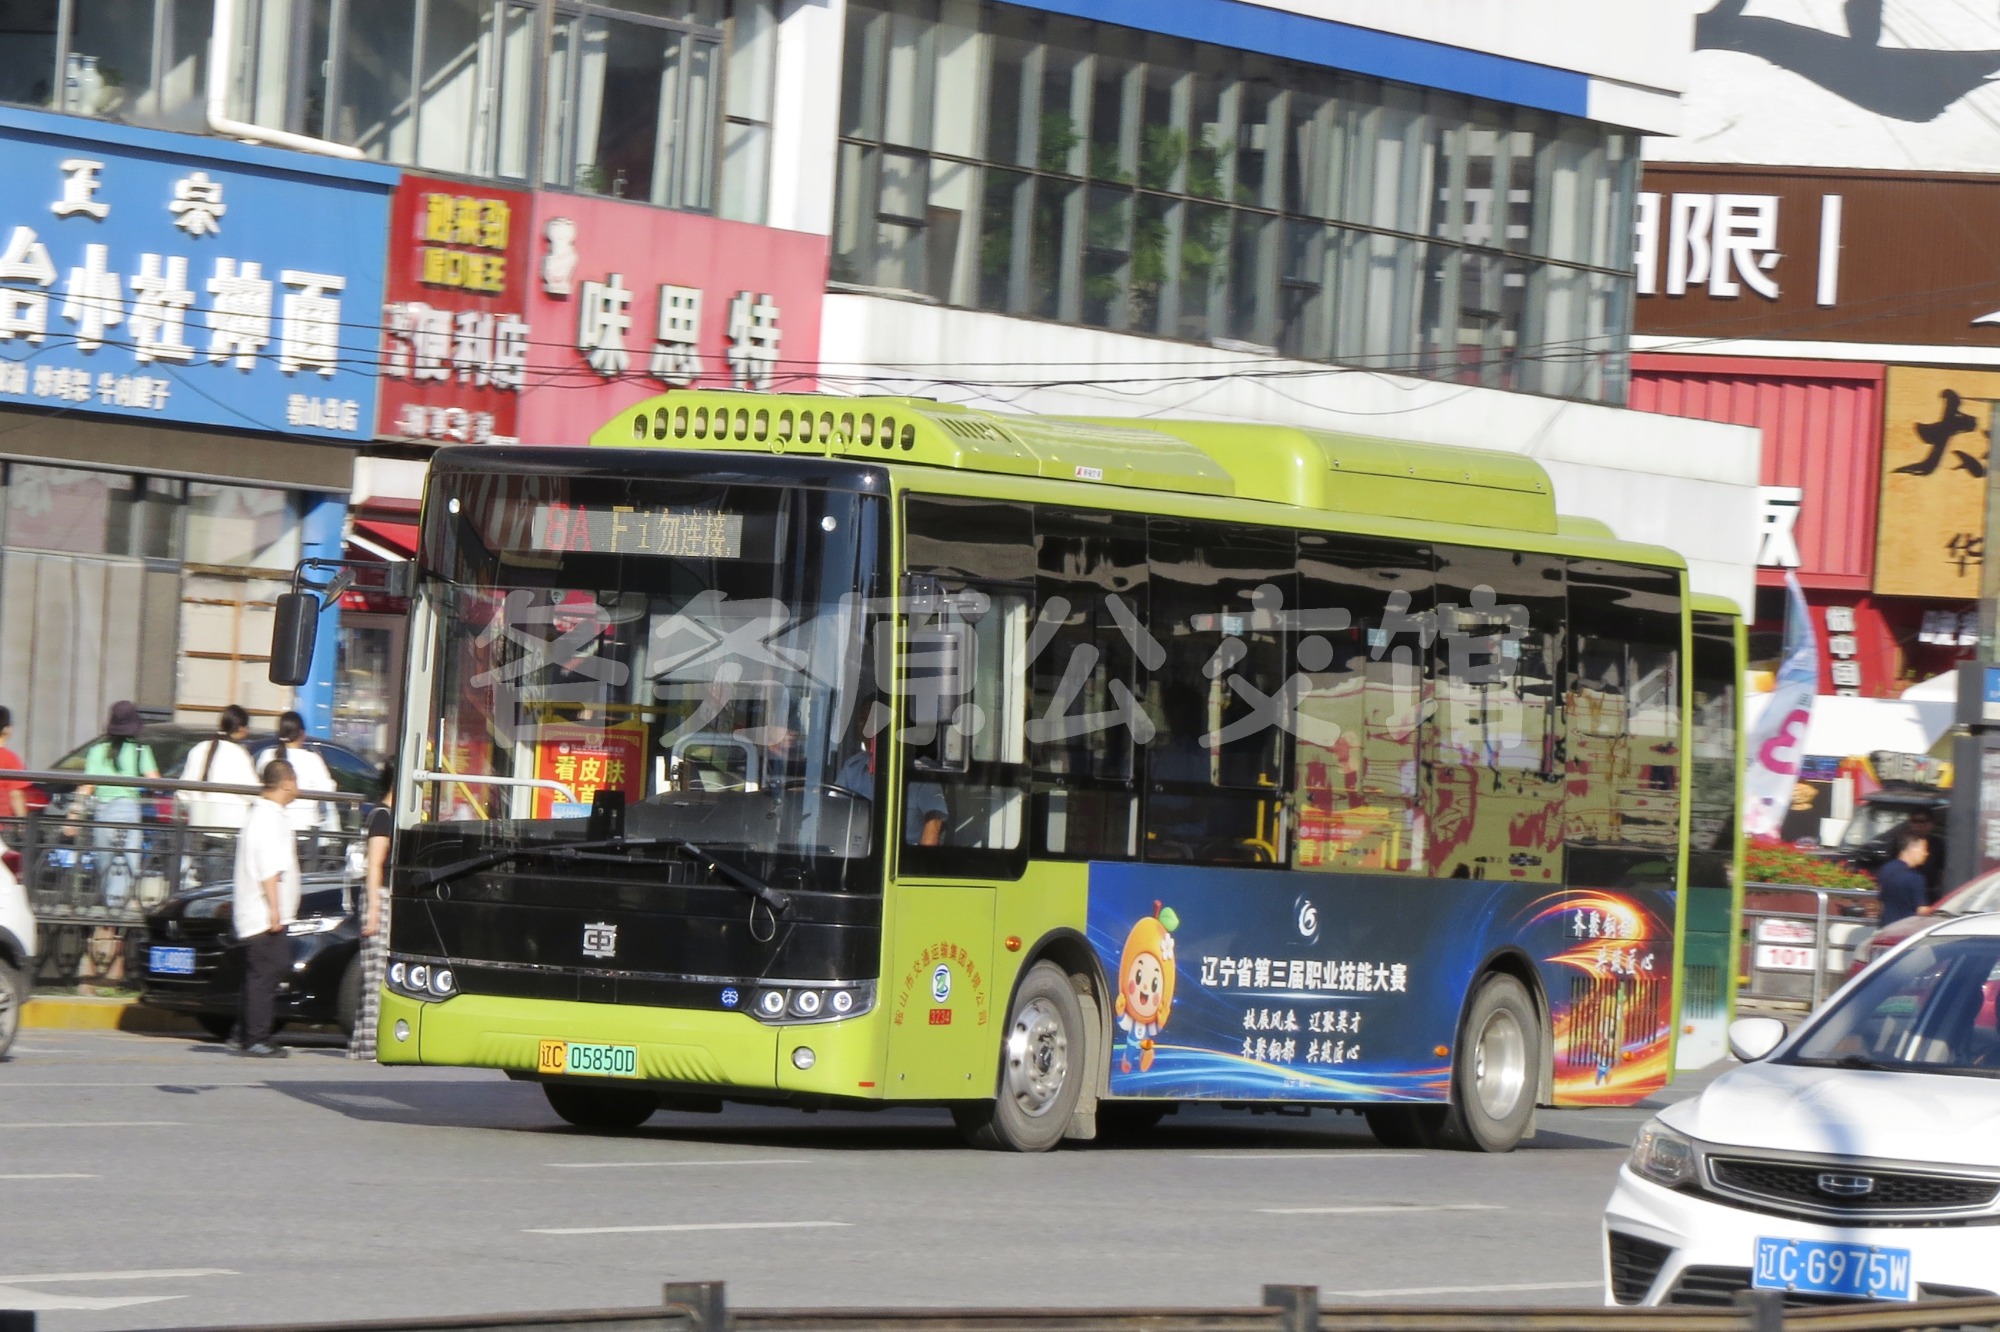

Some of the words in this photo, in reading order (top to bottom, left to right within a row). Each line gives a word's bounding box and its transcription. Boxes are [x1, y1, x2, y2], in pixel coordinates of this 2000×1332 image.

[1634, 191, 1784, 300] 限
[555, 755, 626, 785] 看皮肤
[1200, 956, 1408, 993] 辽宁省第三届职业技能大赛
[1243, 1008, 1299, 1032] 技展风采
[1308, 1010, 1362, 1034] 辽聚英才
[1241, 1036, 1296, 1064] 齐聚钢都
[1759, 1243, 1909, 1292] 辽C·G975W
